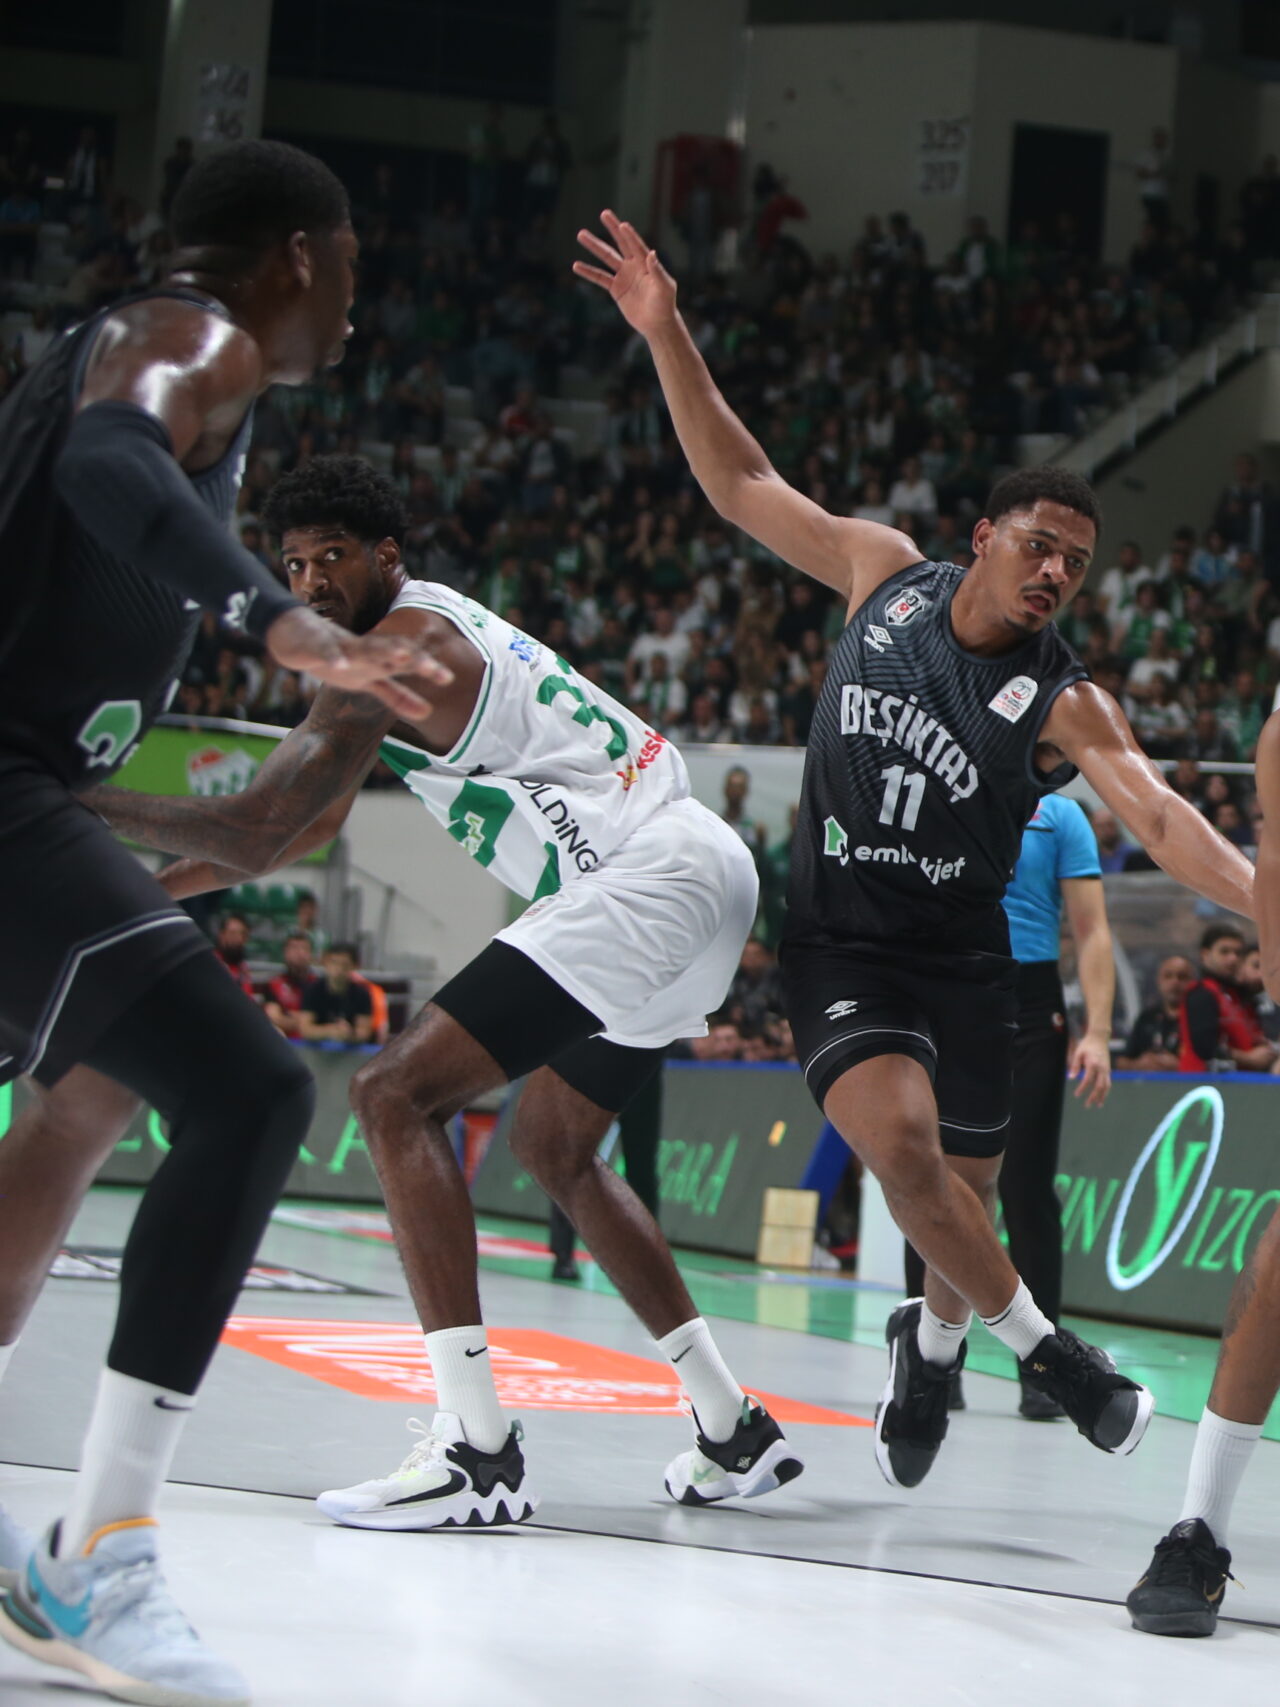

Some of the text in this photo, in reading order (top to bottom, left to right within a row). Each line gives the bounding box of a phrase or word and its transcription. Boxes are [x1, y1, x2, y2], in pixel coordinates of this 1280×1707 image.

[536, 654, 629, 762] 3
[840, 684, 980, 804] BEŞİKTAŞ
[878, 764, 927, 832] 11
